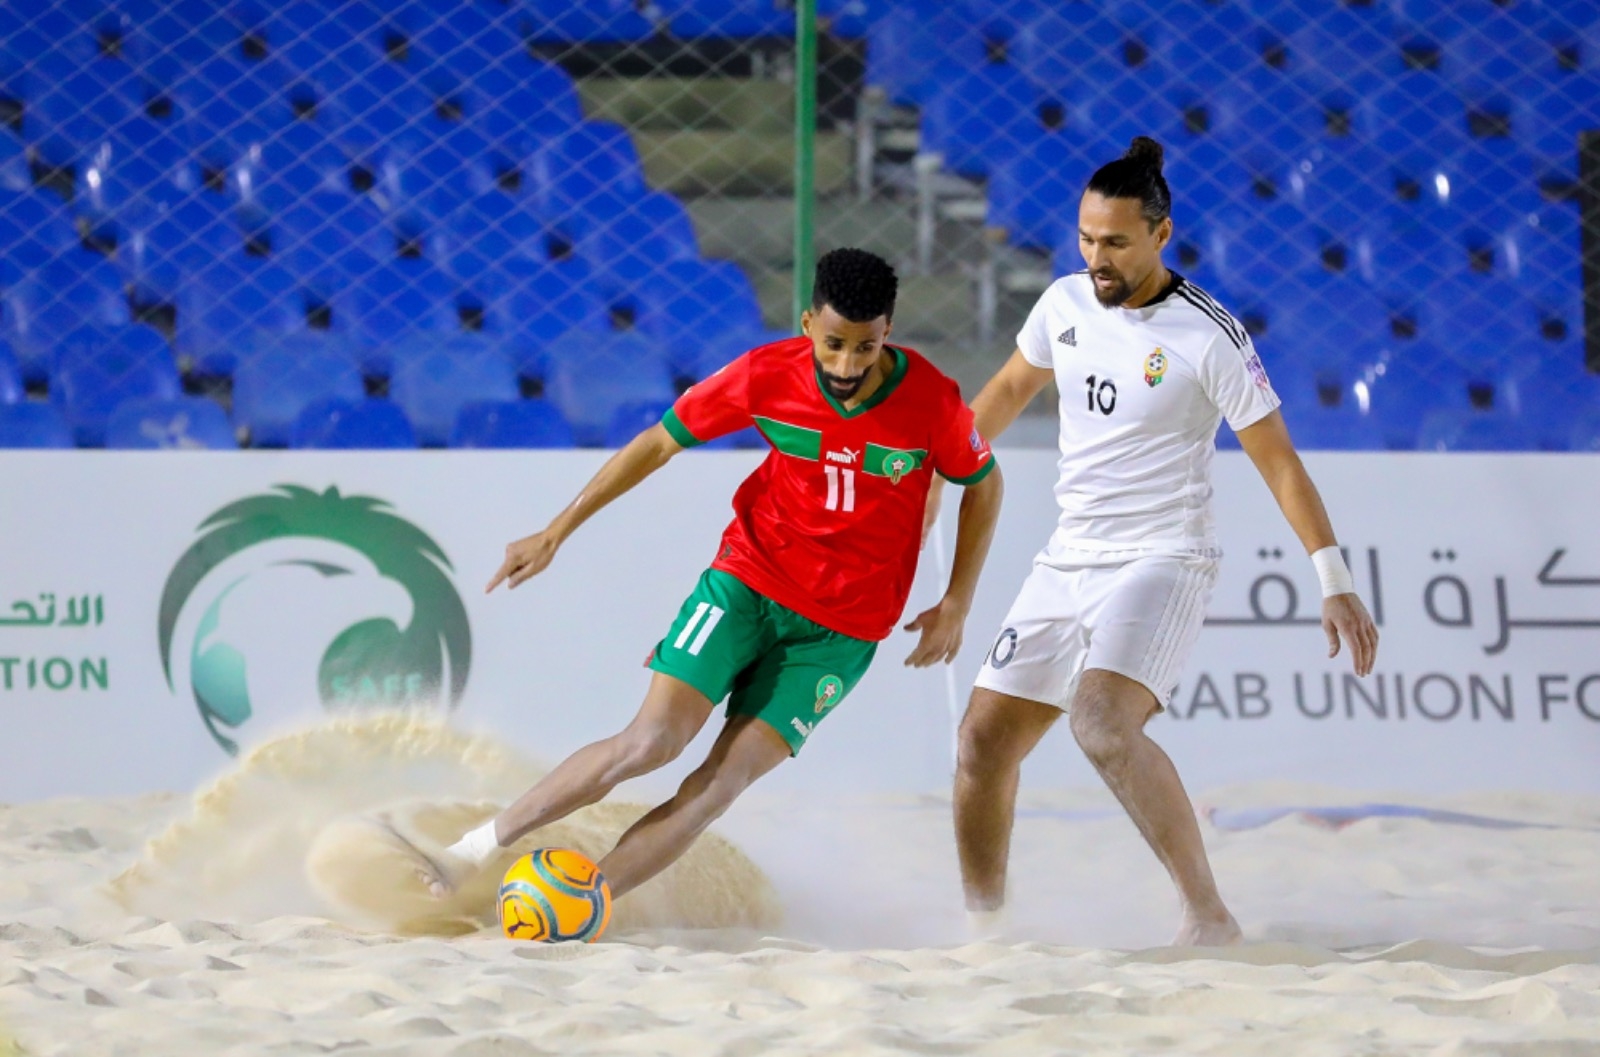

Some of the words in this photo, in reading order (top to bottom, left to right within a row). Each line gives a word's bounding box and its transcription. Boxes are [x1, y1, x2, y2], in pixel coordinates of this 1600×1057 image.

[1085, 374, 1117, 415] 10
[826, 450, 852, 464] PUMA
[824, 464, 855, 512] 11
[673, 601, 725, 656] 11
[983, 627, 1018, 670] 0
[0, 656, 108, 691] TION
[1294, 671, 1514, 722] UNION
